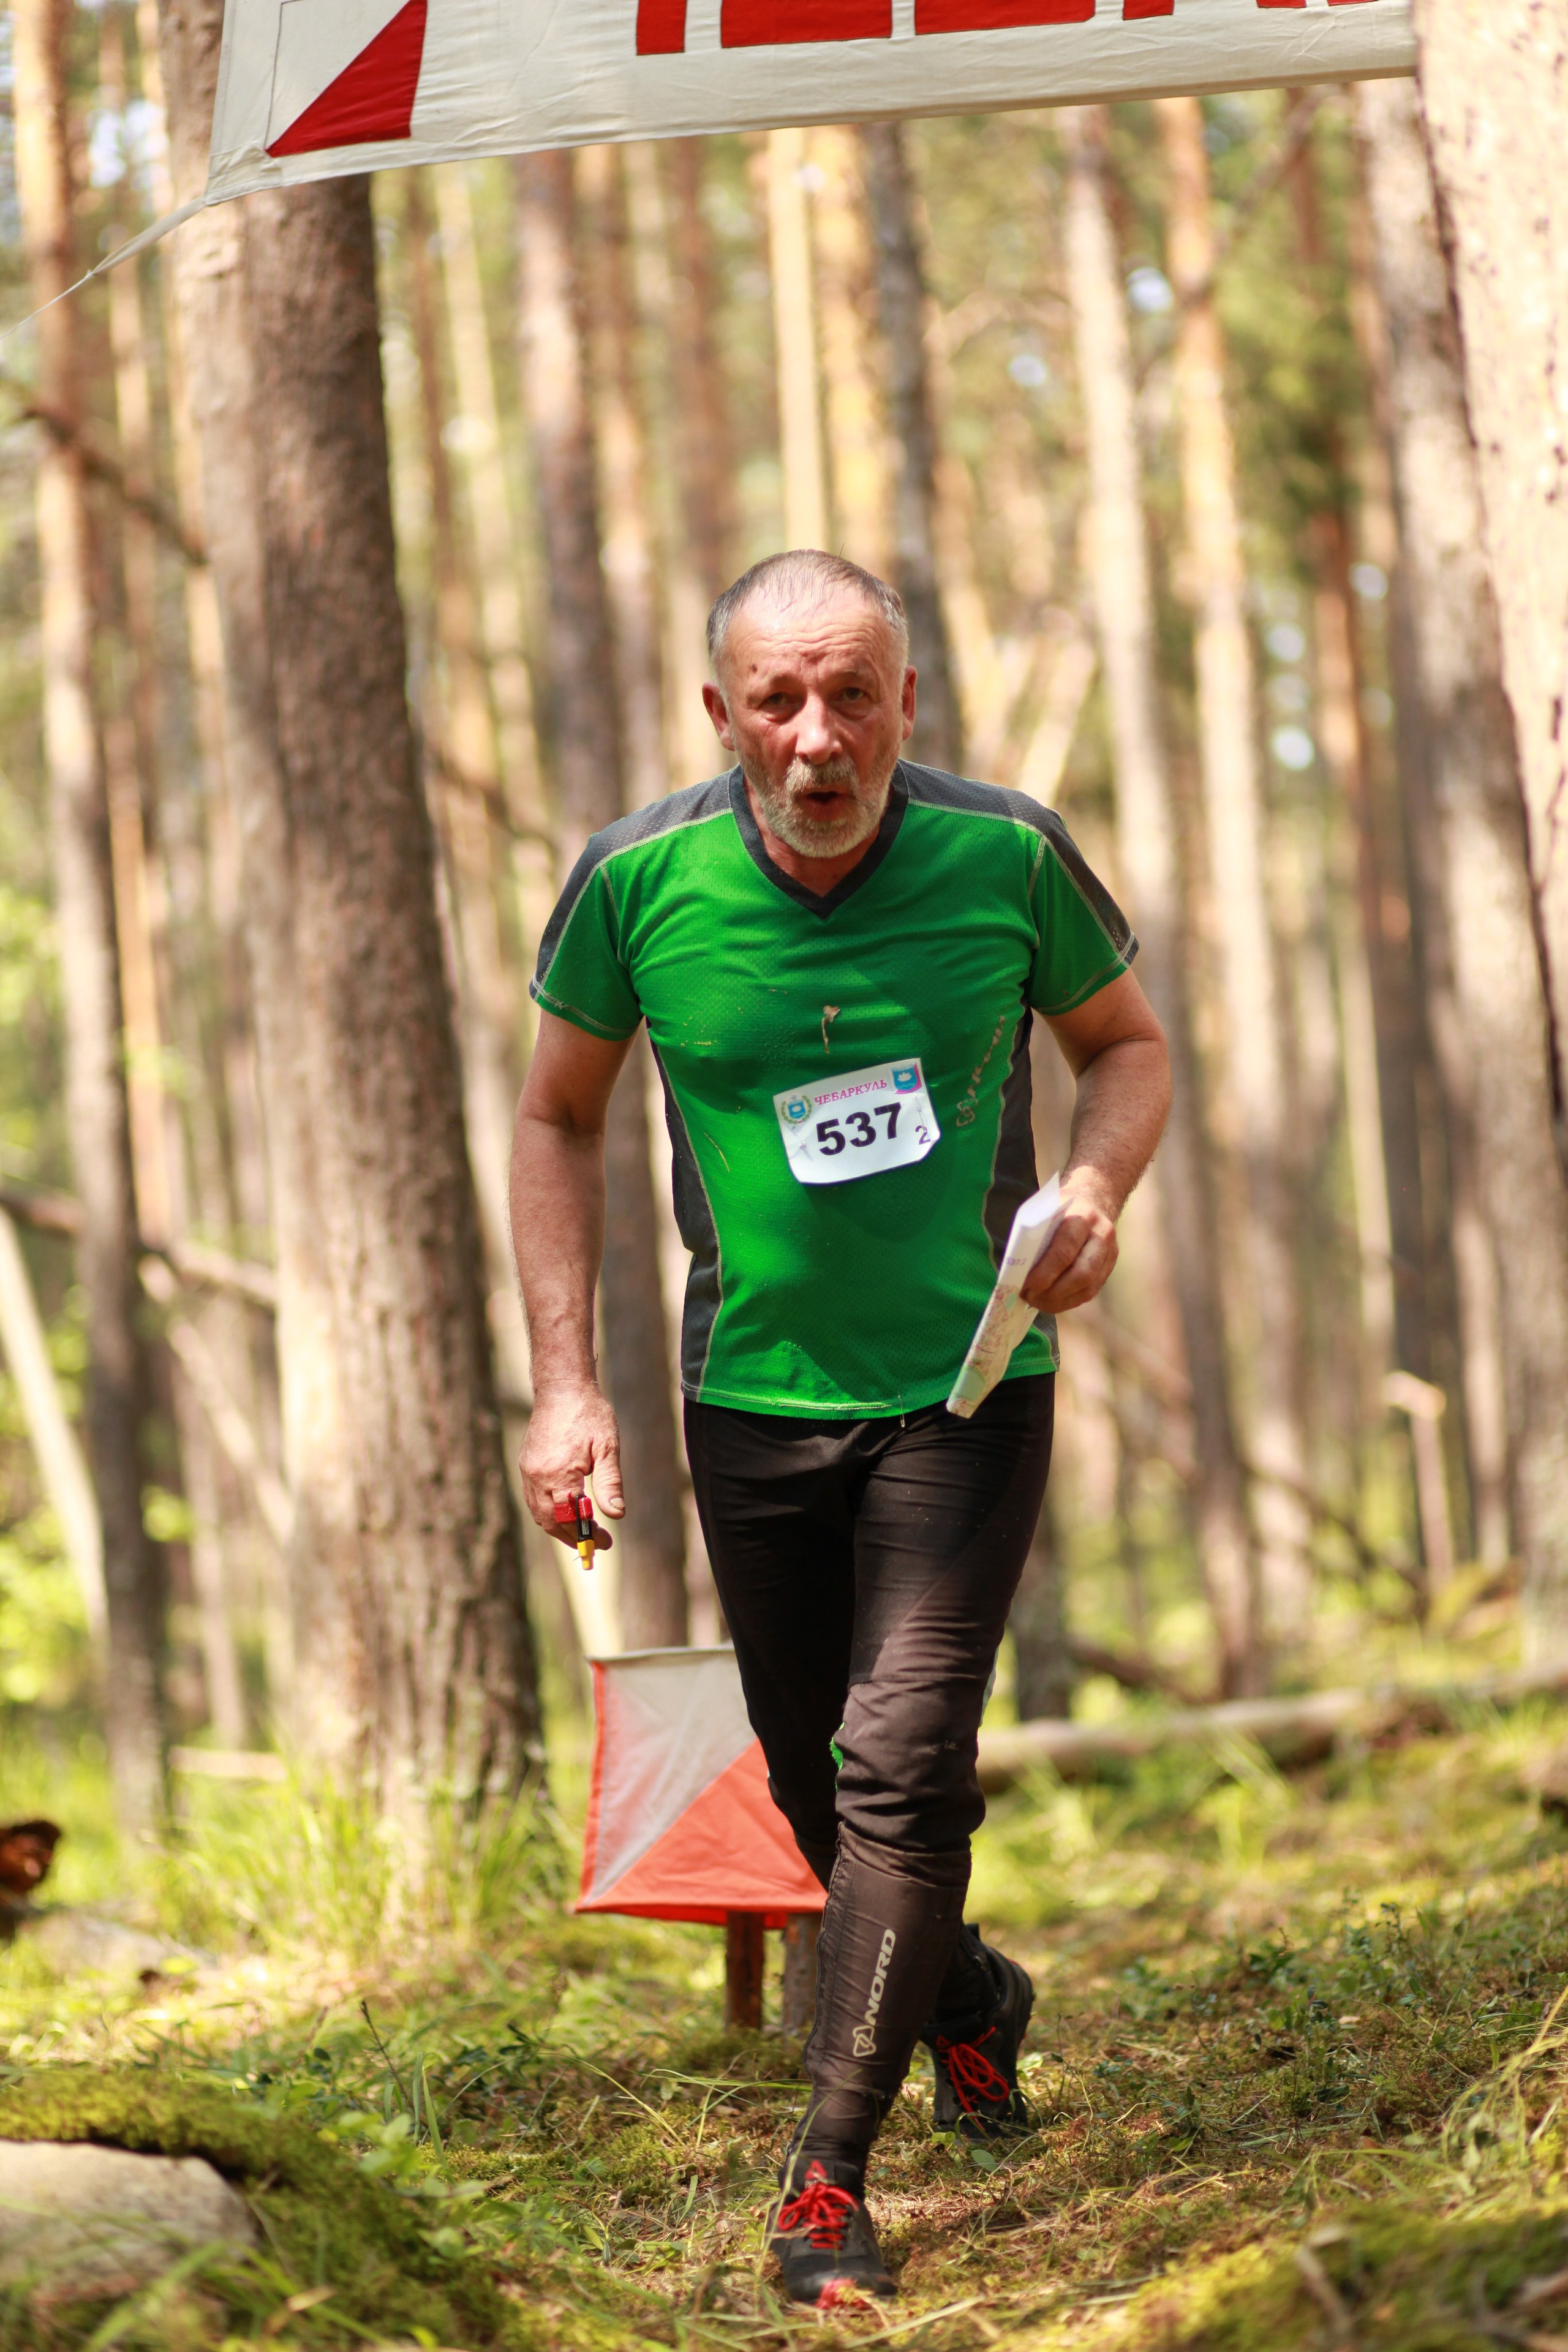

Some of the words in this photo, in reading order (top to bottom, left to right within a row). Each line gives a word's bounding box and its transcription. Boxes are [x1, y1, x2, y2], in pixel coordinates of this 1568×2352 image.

[814, 1079, 888, 1105] ЧЕБАРКУЛЬ
[816, 1102, 901, 1156] 537
[915, 1125, 931, 1145] 2
